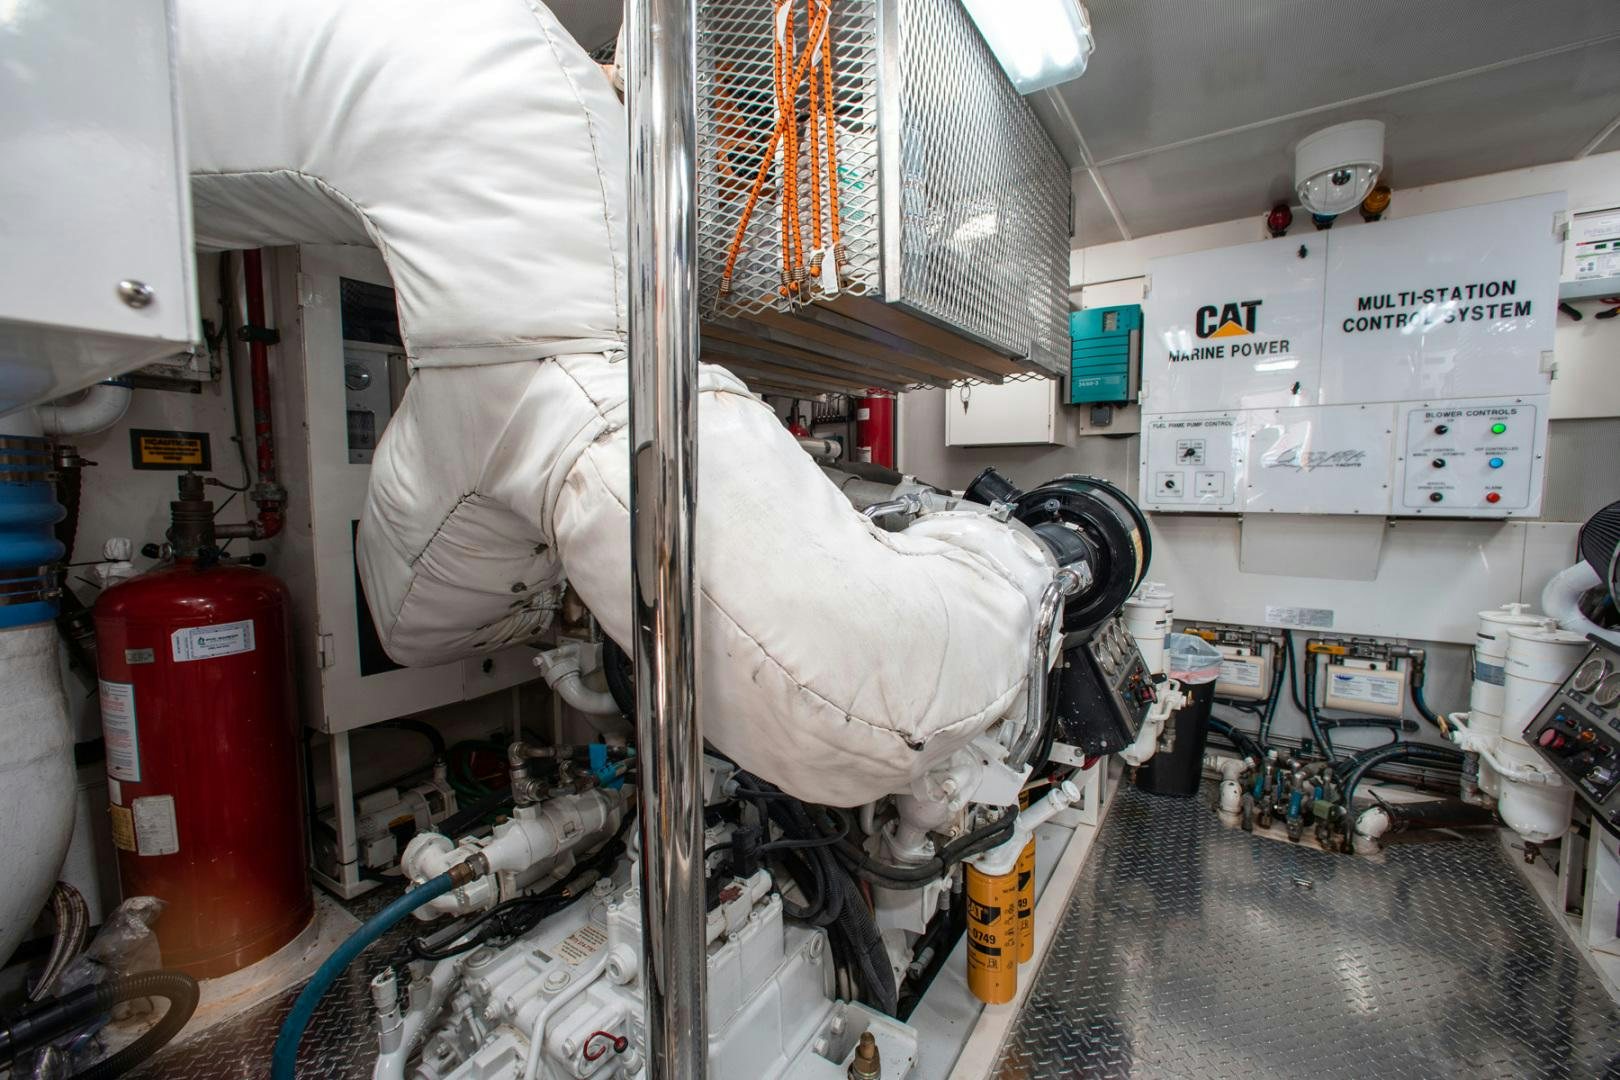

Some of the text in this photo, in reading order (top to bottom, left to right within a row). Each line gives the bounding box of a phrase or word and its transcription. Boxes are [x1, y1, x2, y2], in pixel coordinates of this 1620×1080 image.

[1358, 280, 1516, 311] MULTI-STATION
[1196, 299, 1262, 339] CAT
[1444, 301, 1531, 323] SYSTEM
[1169, 340, 1289, 362] MARINE POWER
[1425, 408, 1517, 418] BLOWER CONTROLS
